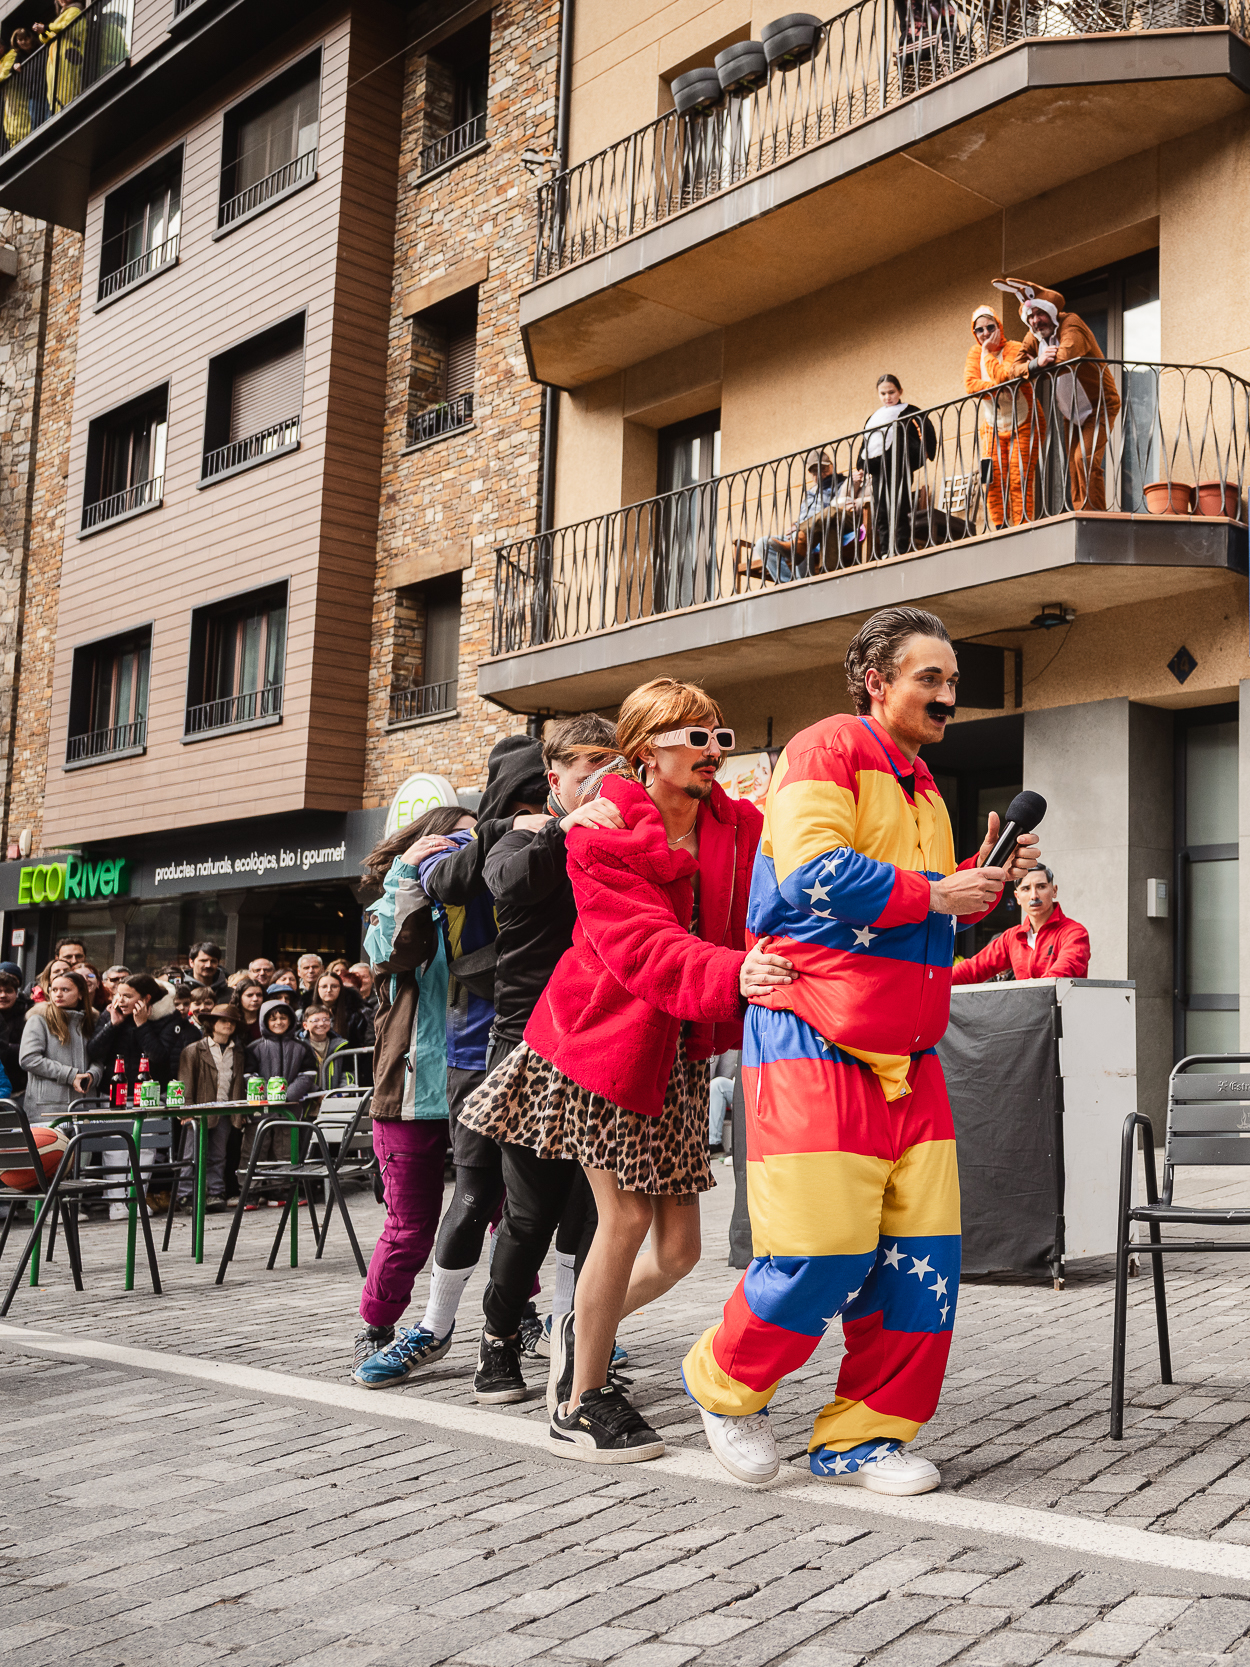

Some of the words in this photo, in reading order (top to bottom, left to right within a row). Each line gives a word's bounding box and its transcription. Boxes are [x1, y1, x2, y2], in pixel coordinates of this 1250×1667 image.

[155, 861, 195, 885] productes
[279, 849, 294, 868] bio
[297, 849, 301, 865] i
[302, 841, 346, 870] gourmet
